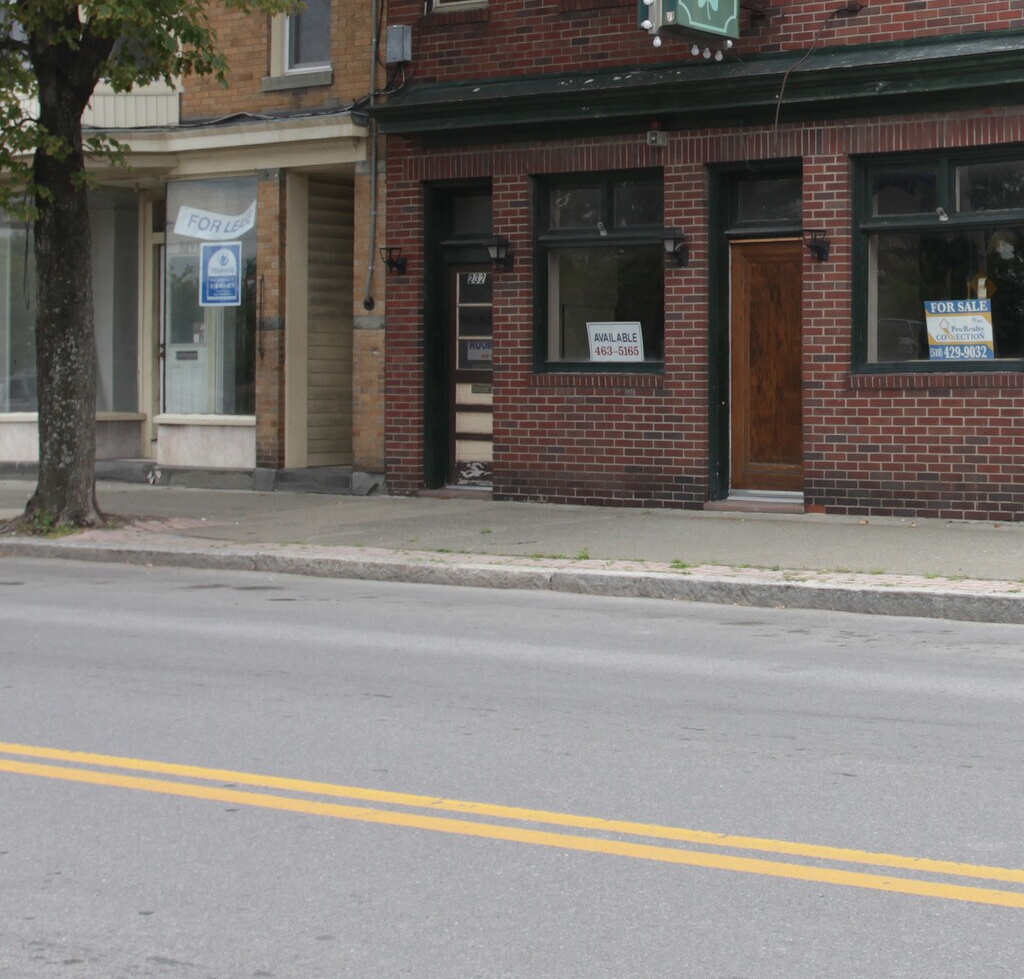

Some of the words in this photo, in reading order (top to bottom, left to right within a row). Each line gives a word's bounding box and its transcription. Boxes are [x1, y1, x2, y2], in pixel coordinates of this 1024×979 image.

[187, 214, 222, 233] FOR
[467, 272, 487, 285] 232
[930, 302, 955, 313] FOR
[957, 300, 988, 312] SALE
[594, 332, 637, 343] AVAILABLE
[594, 345, 639, 356] 463-5165
[944, 345, 988, 359] 429-9032
